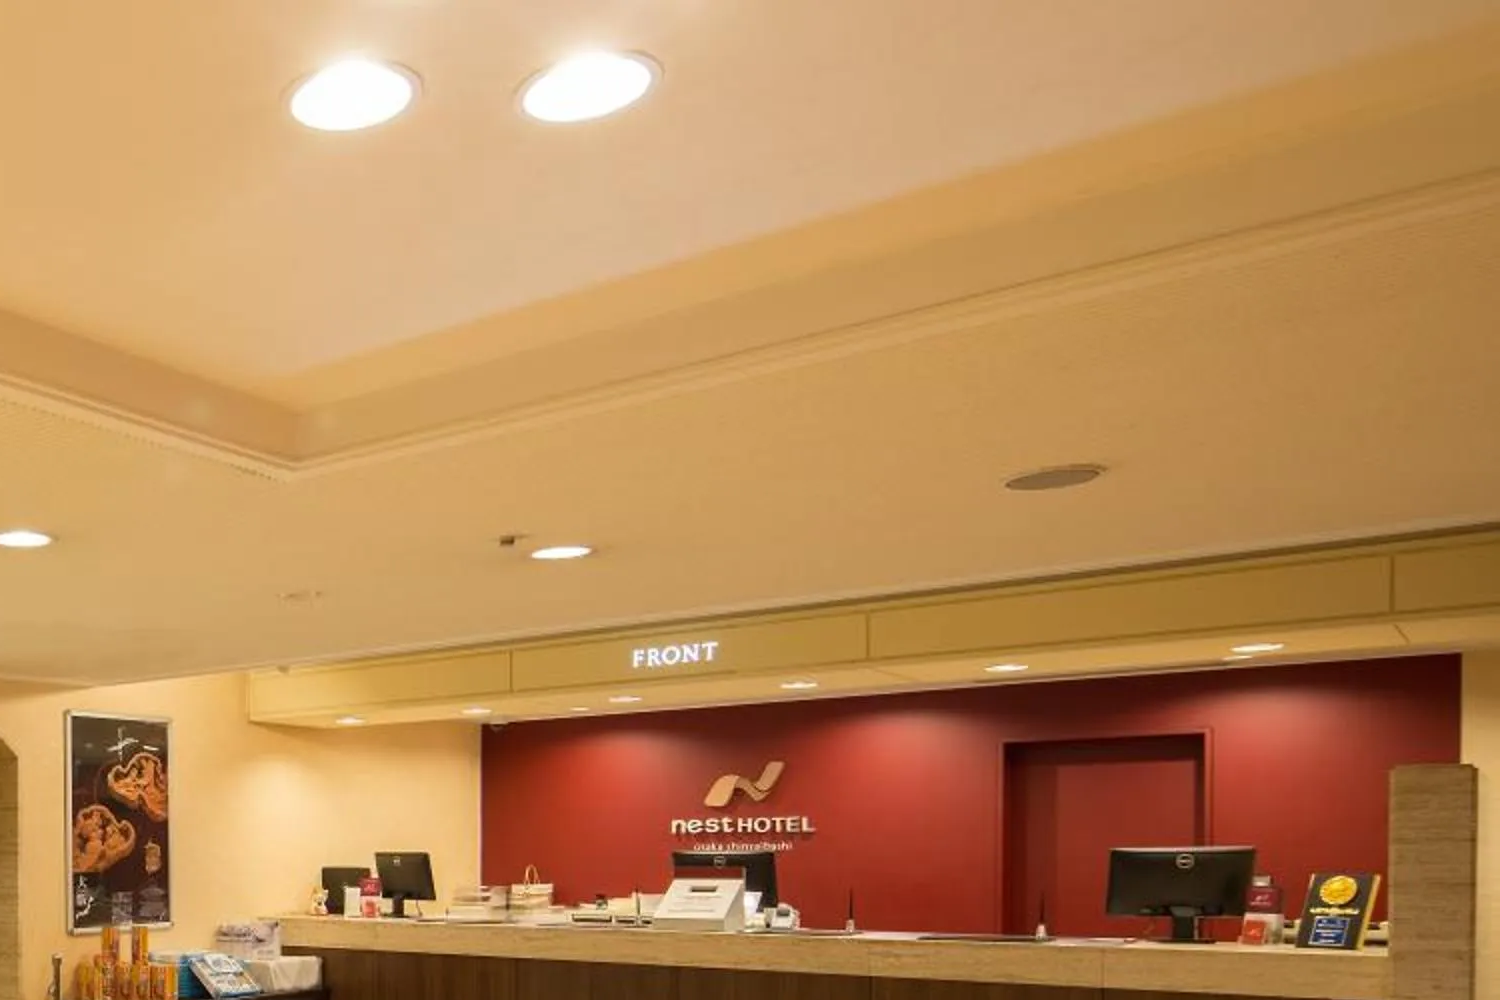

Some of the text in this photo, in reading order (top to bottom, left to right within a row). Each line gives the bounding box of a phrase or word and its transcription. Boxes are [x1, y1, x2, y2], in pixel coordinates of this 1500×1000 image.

[632, 641, 719, 668] FRONT
[671, 816, 816, 833] nest HOTEL
